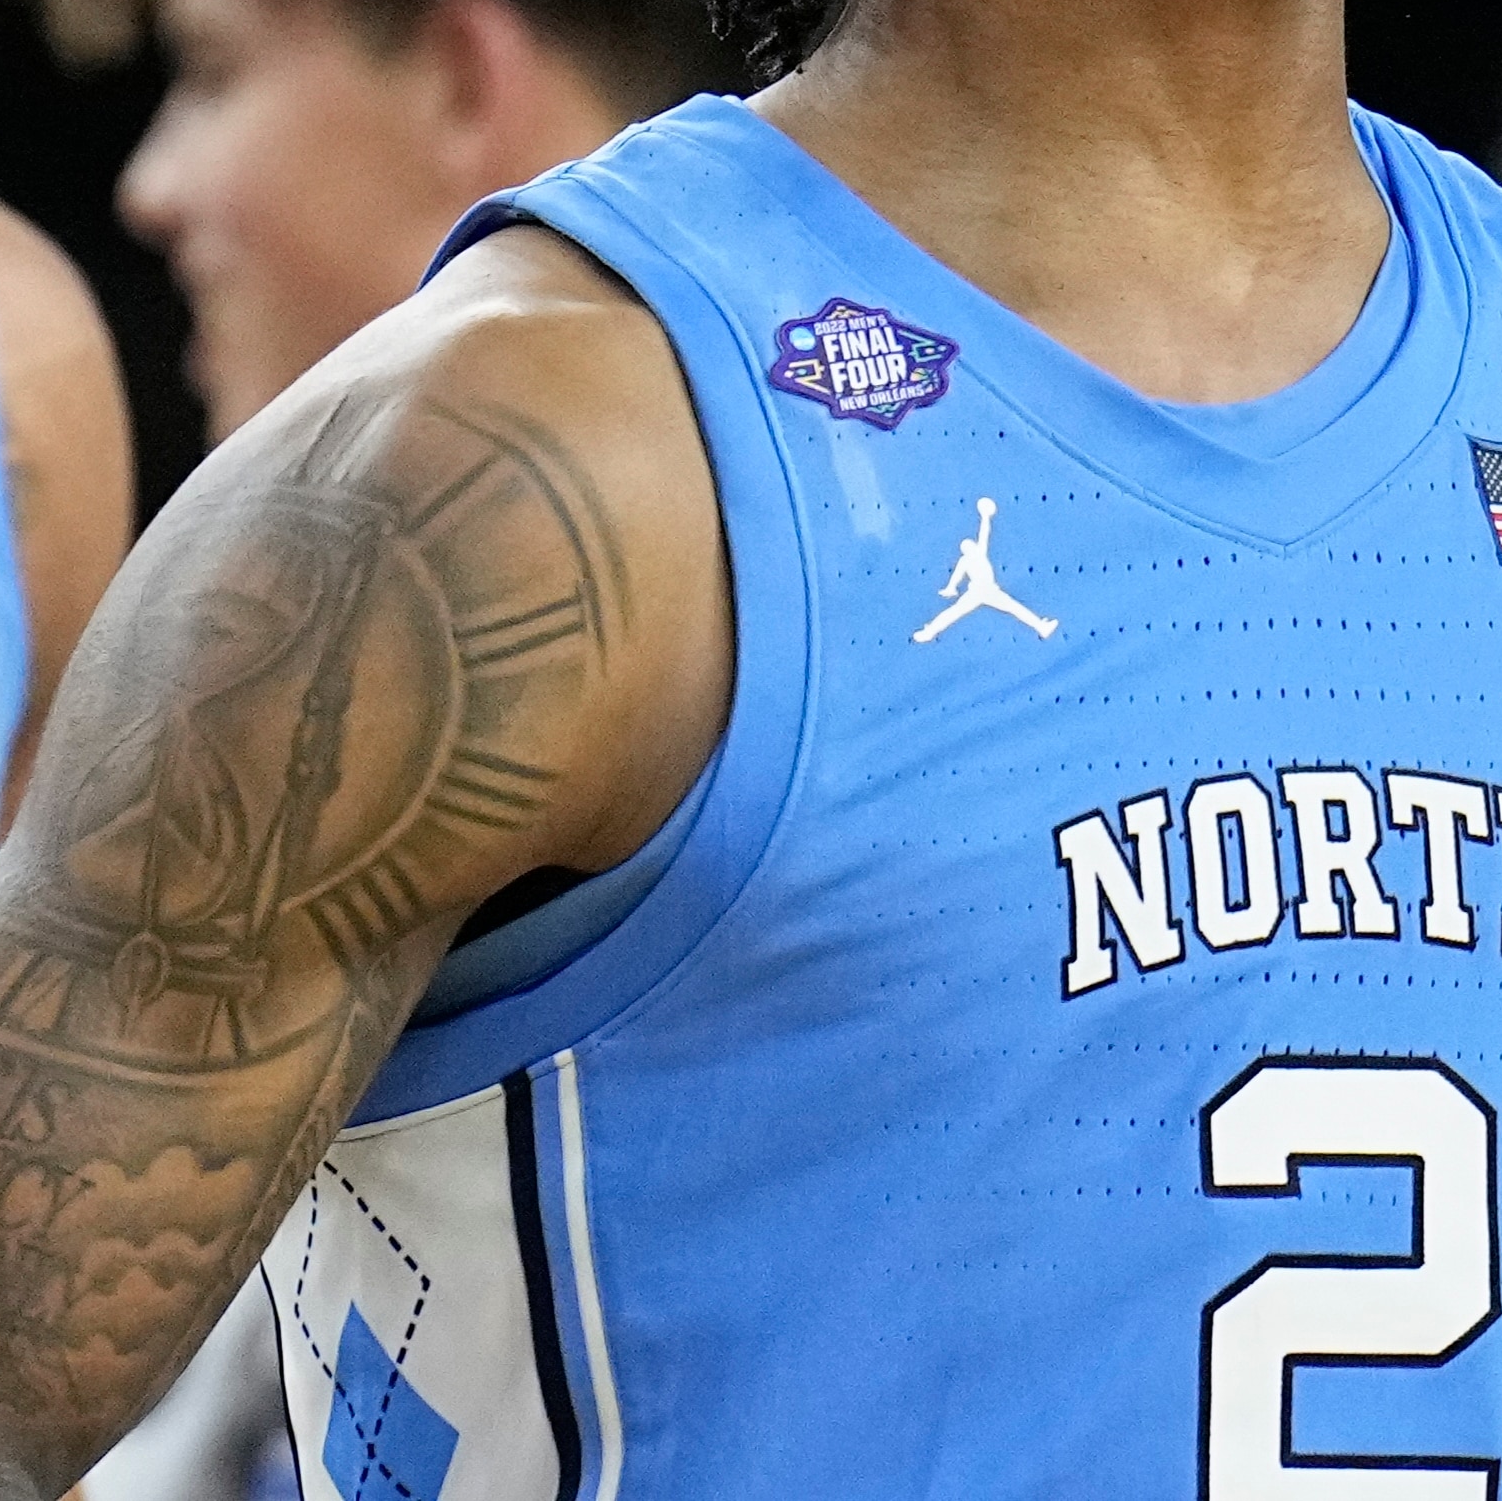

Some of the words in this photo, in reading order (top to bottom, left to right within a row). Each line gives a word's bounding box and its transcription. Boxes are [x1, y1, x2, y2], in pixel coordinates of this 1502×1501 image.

[814, 318, 847, 336] 2022
[849, 313, 887, 331] MEN'S
[822, 326, 903, 364] FINAL
[828, 353, 907, 395] FOUR
[839, 394, 868, 412] NEW
[869, 386, 925, 406] ORLEANS
[1199, 1052, 1502, 1501] 2
